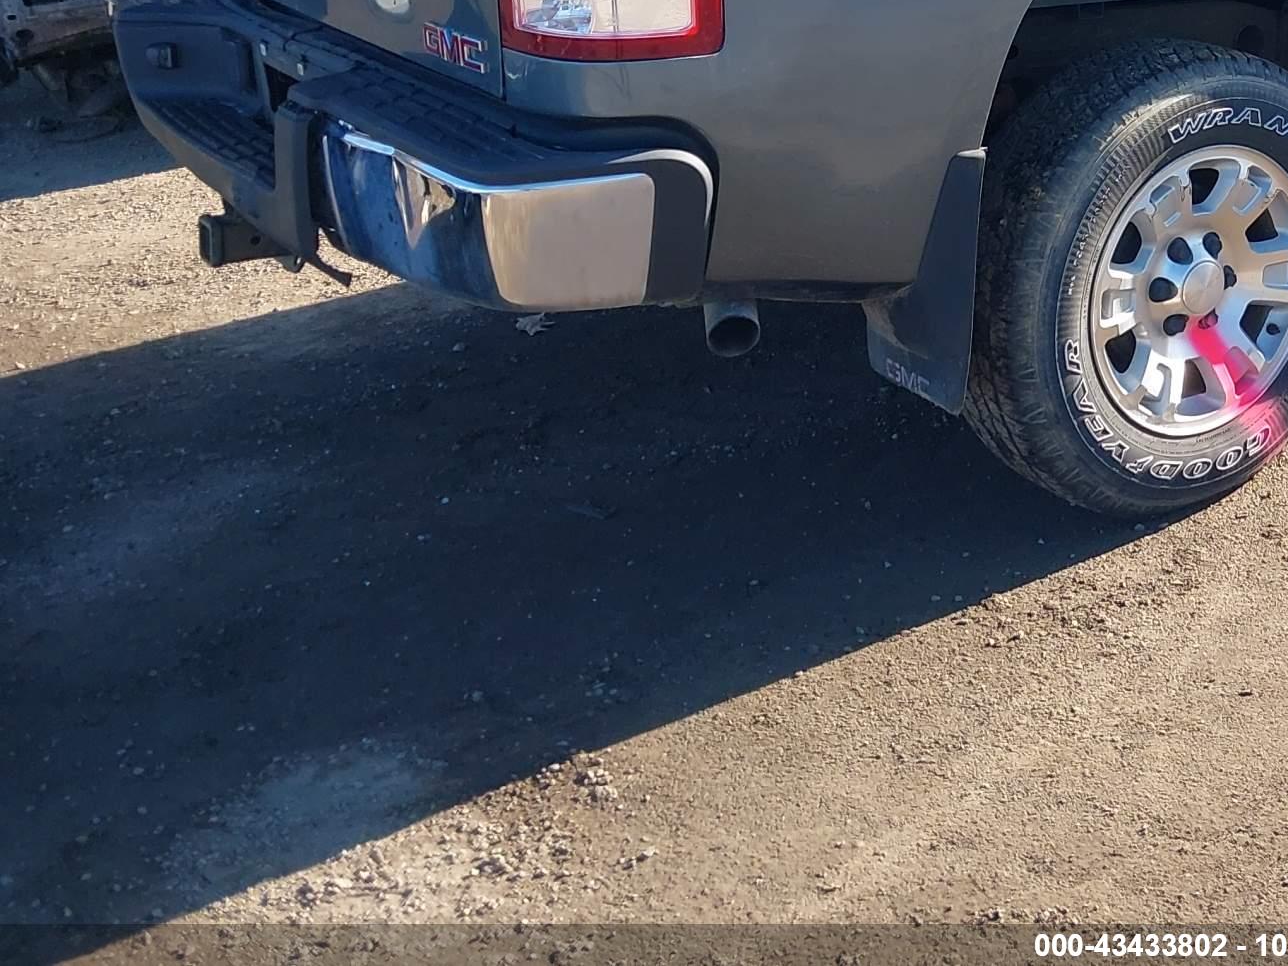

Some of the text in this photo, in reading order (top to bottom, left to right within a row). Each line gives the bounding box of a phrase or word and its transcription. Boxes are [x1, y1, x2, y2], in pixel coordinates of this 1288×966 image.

[423, 21, 488, 74] GMC
[886, 357, 930, 394] GMC
[1064, 338, 1272, 480] GOODYEAR
